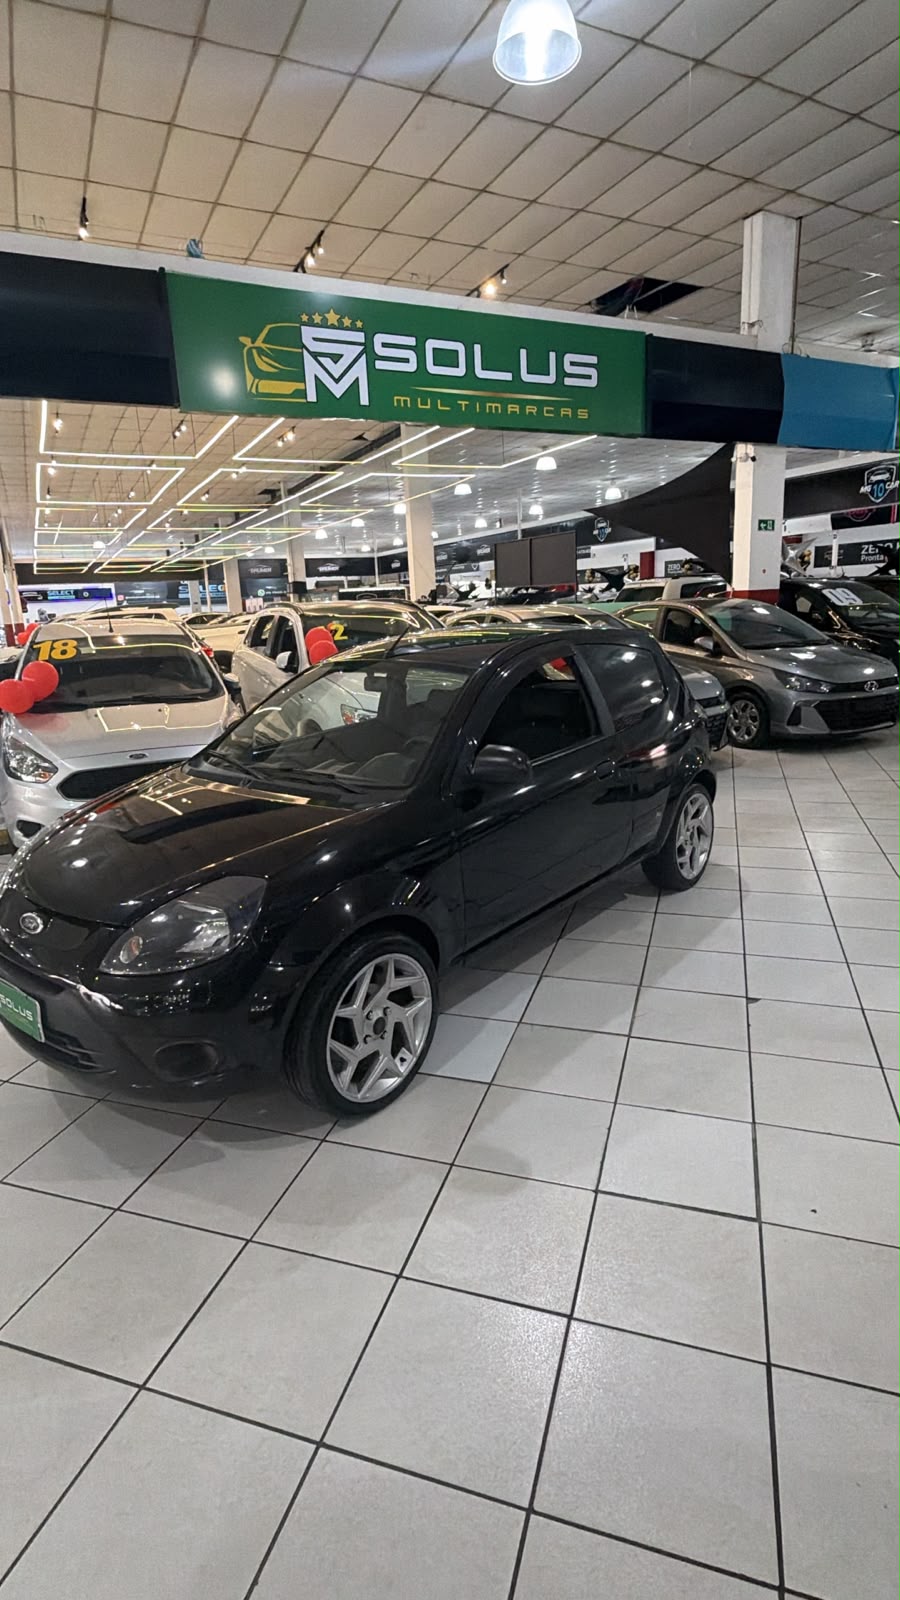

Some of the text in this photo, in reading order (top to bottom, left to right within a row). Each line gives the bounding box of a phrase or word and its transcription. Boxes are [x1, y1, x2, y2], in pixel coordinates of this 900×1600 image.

[373, 332, 599, 389] SOLUS
[393, 396, 590, 419] MULTIMARCAS
[873, 482, 885, 498] 10
[861, 554, 884, 562] Pronta
[33, 639, 78, 661] 18
[0, 994, 33, 1021] SOLUS
